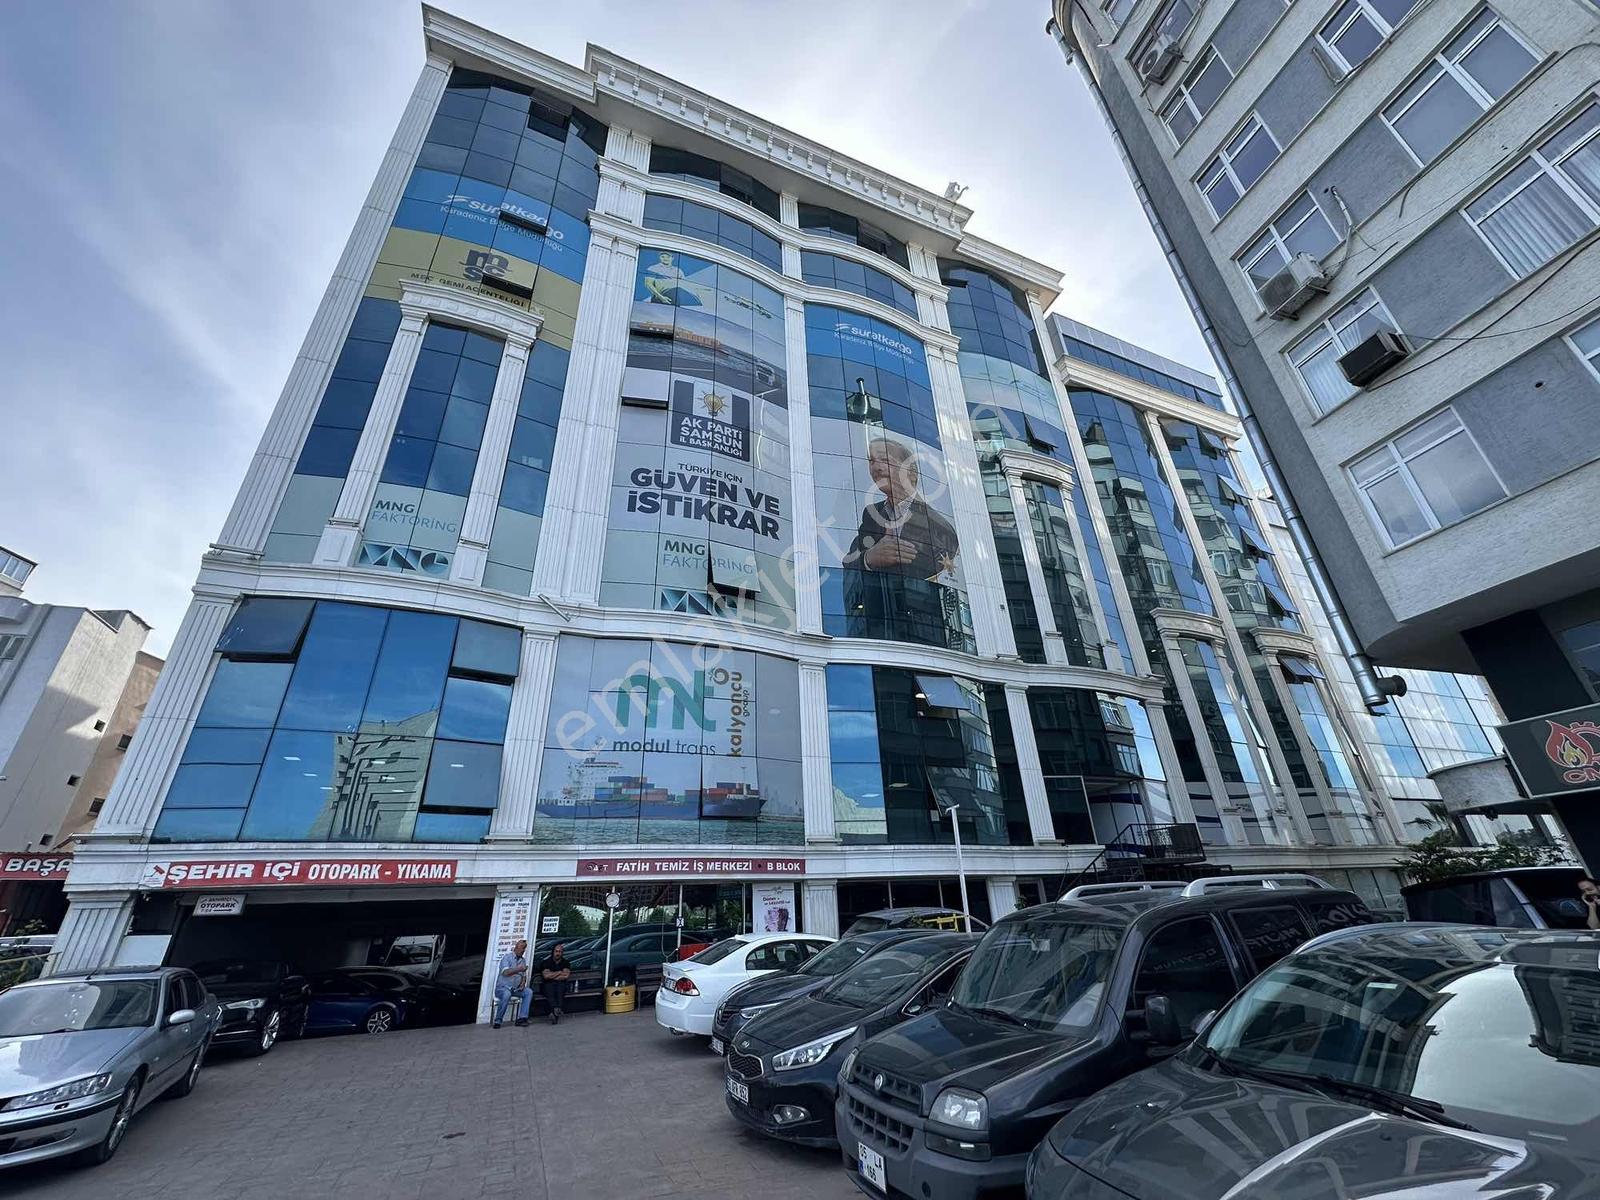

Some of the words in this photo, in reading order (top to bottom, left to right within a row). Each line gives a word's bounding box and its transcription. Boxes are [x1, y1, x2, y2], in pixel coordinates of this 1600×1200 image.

[851, 327, 912, 354] suratkargo
[680, 426, 743, 450] SAMSUN
[681, 416, 702, 429] AK
[707, 421, 742, 440] PARTİ
[678, 463, 723, 478] TÜRKİYE
[630, 467, 737, 502] GÜVEN
[744, 487, 780, 516] VE
[375, 500, 416, 514] MNG
[627, 490, 780, 541] İSTİKRAR
[664, 540, 706, 556] MNG
[727, 671, 746, 757] kalyoncu
[612, 739, 670, 754] modul
[675, 741, 717, 756] trans
[168, 861, 254, 884] ŞEHİR
[262, 861, 301, 881] İÇİ
[308, 863, 380, 880] OTOPARK
[397, 863, 452, 880] YIKAMA
[616, 861, 650, 872] FATİH
[655, 860, 690, 872] TEMİZ
[693, 860, 704, 874] İŞ
[706, 859, 753, 872] MERKEZİ
[767, 862, 774, 871] B
[776, 862, 801, 872] BLOK
